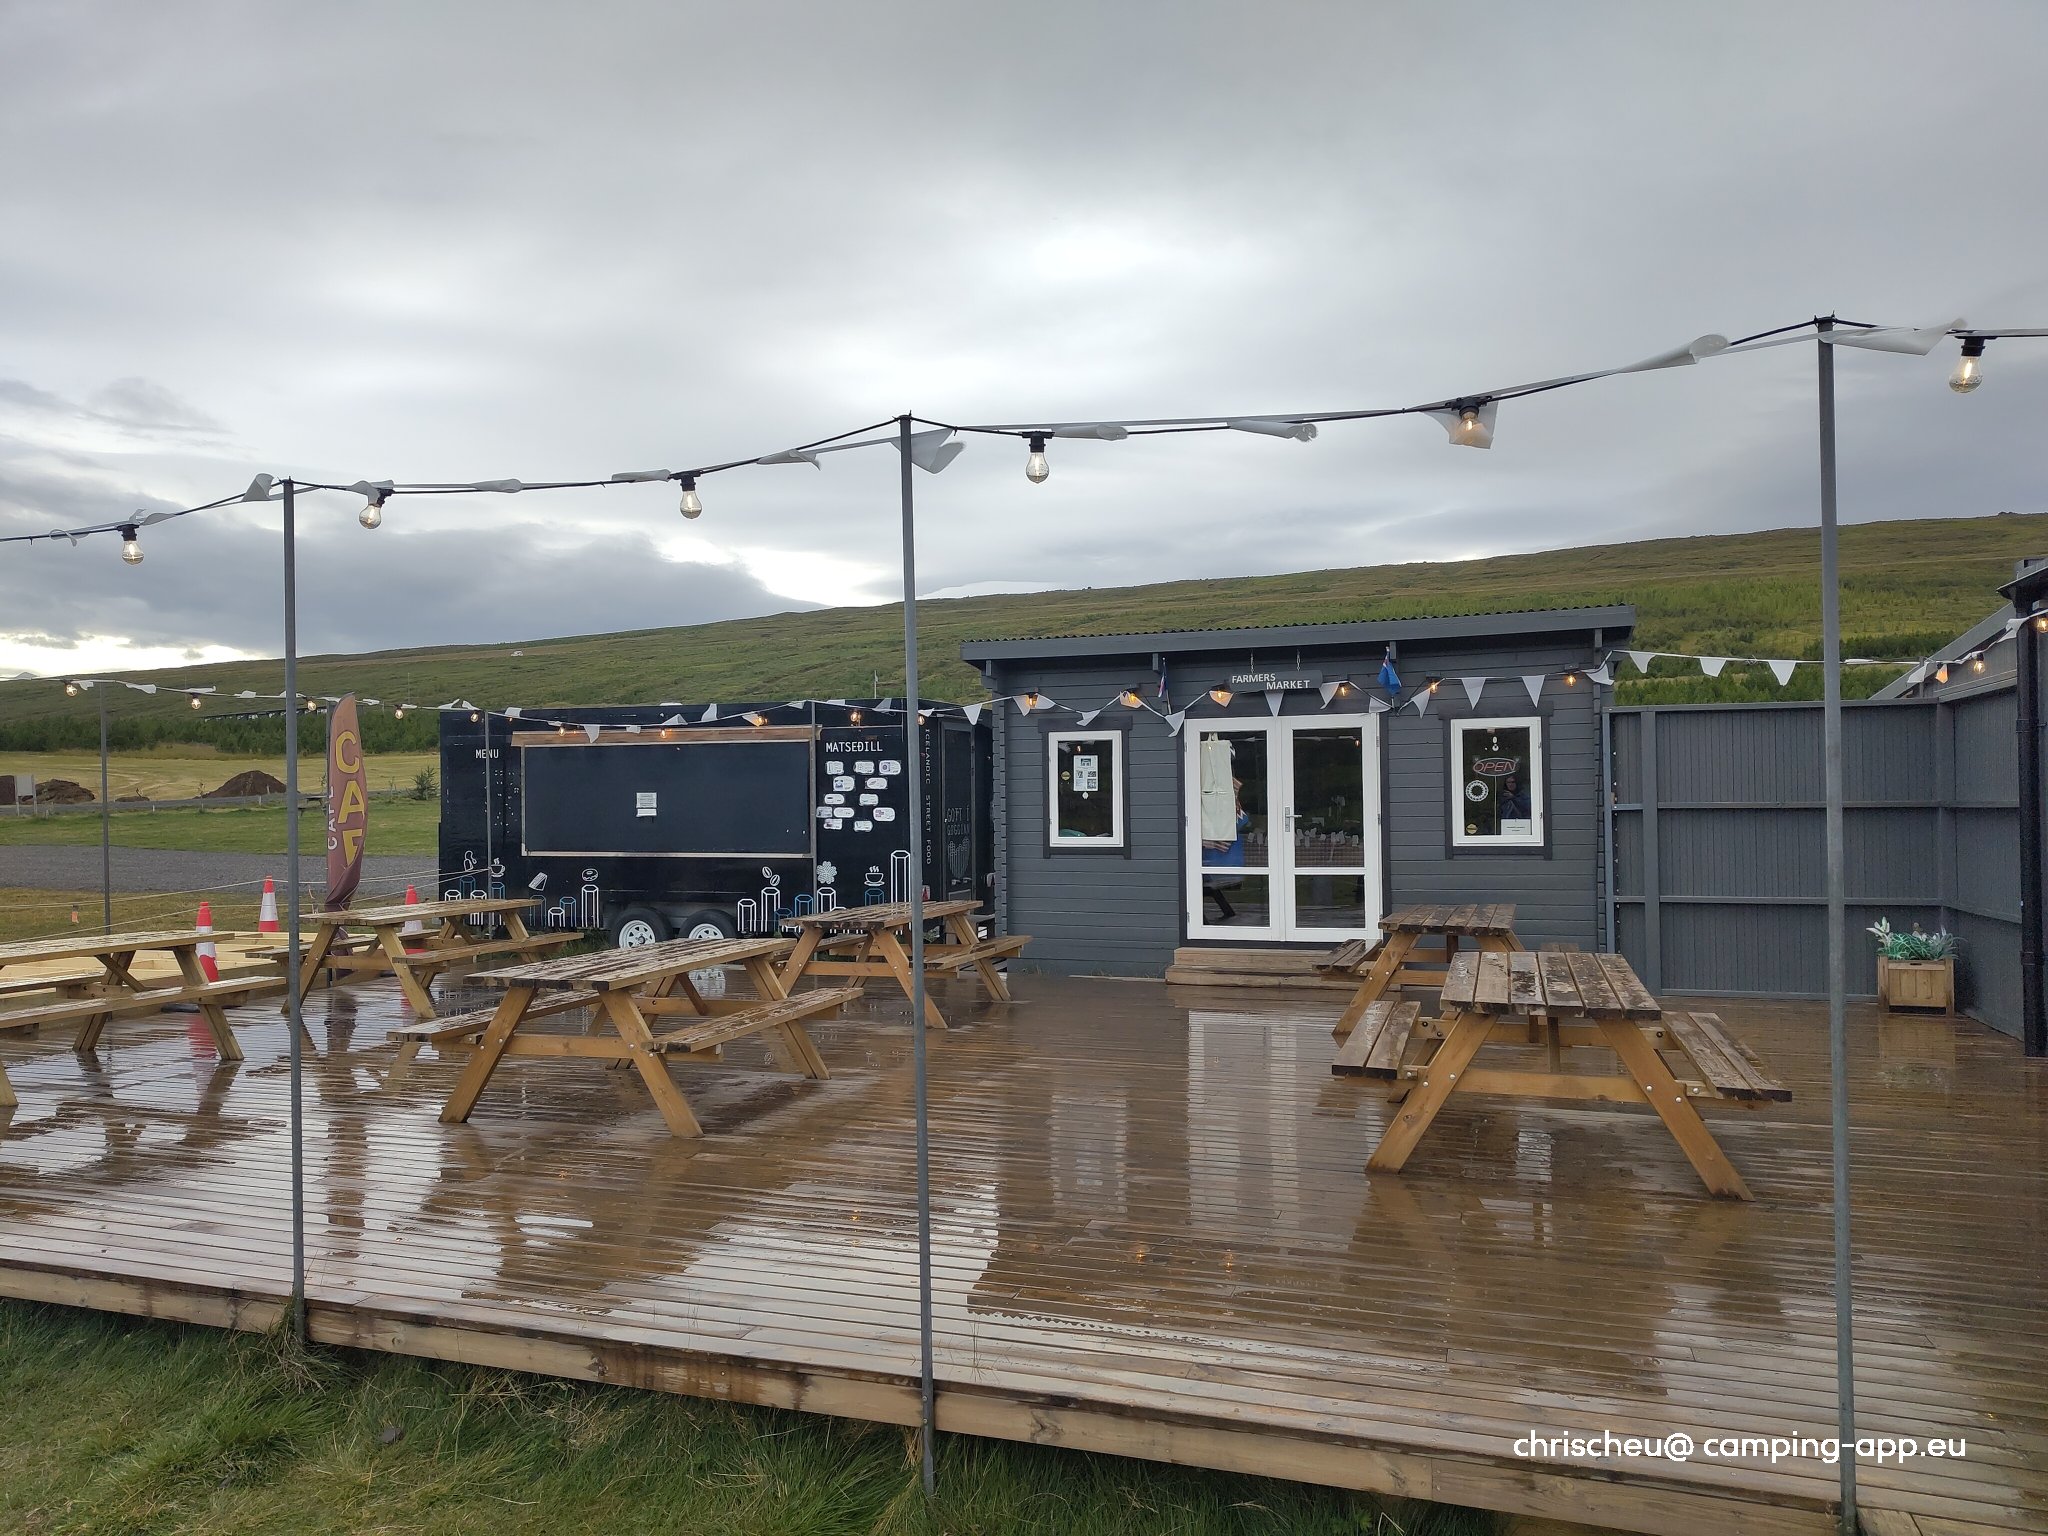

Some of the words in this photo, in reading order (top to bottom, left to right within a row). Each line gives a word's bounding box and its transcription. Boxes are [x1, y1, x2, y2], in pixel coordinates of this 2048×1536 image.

[1231, 673, 1276, 684] FARMERS
[1266, 680, 1310, 690] MARKET
[825, 741, 883, 753] MATSEÐILL
[475, 748, 499, 759] MENU
[1473, 761, 1516, 772] OPEN
